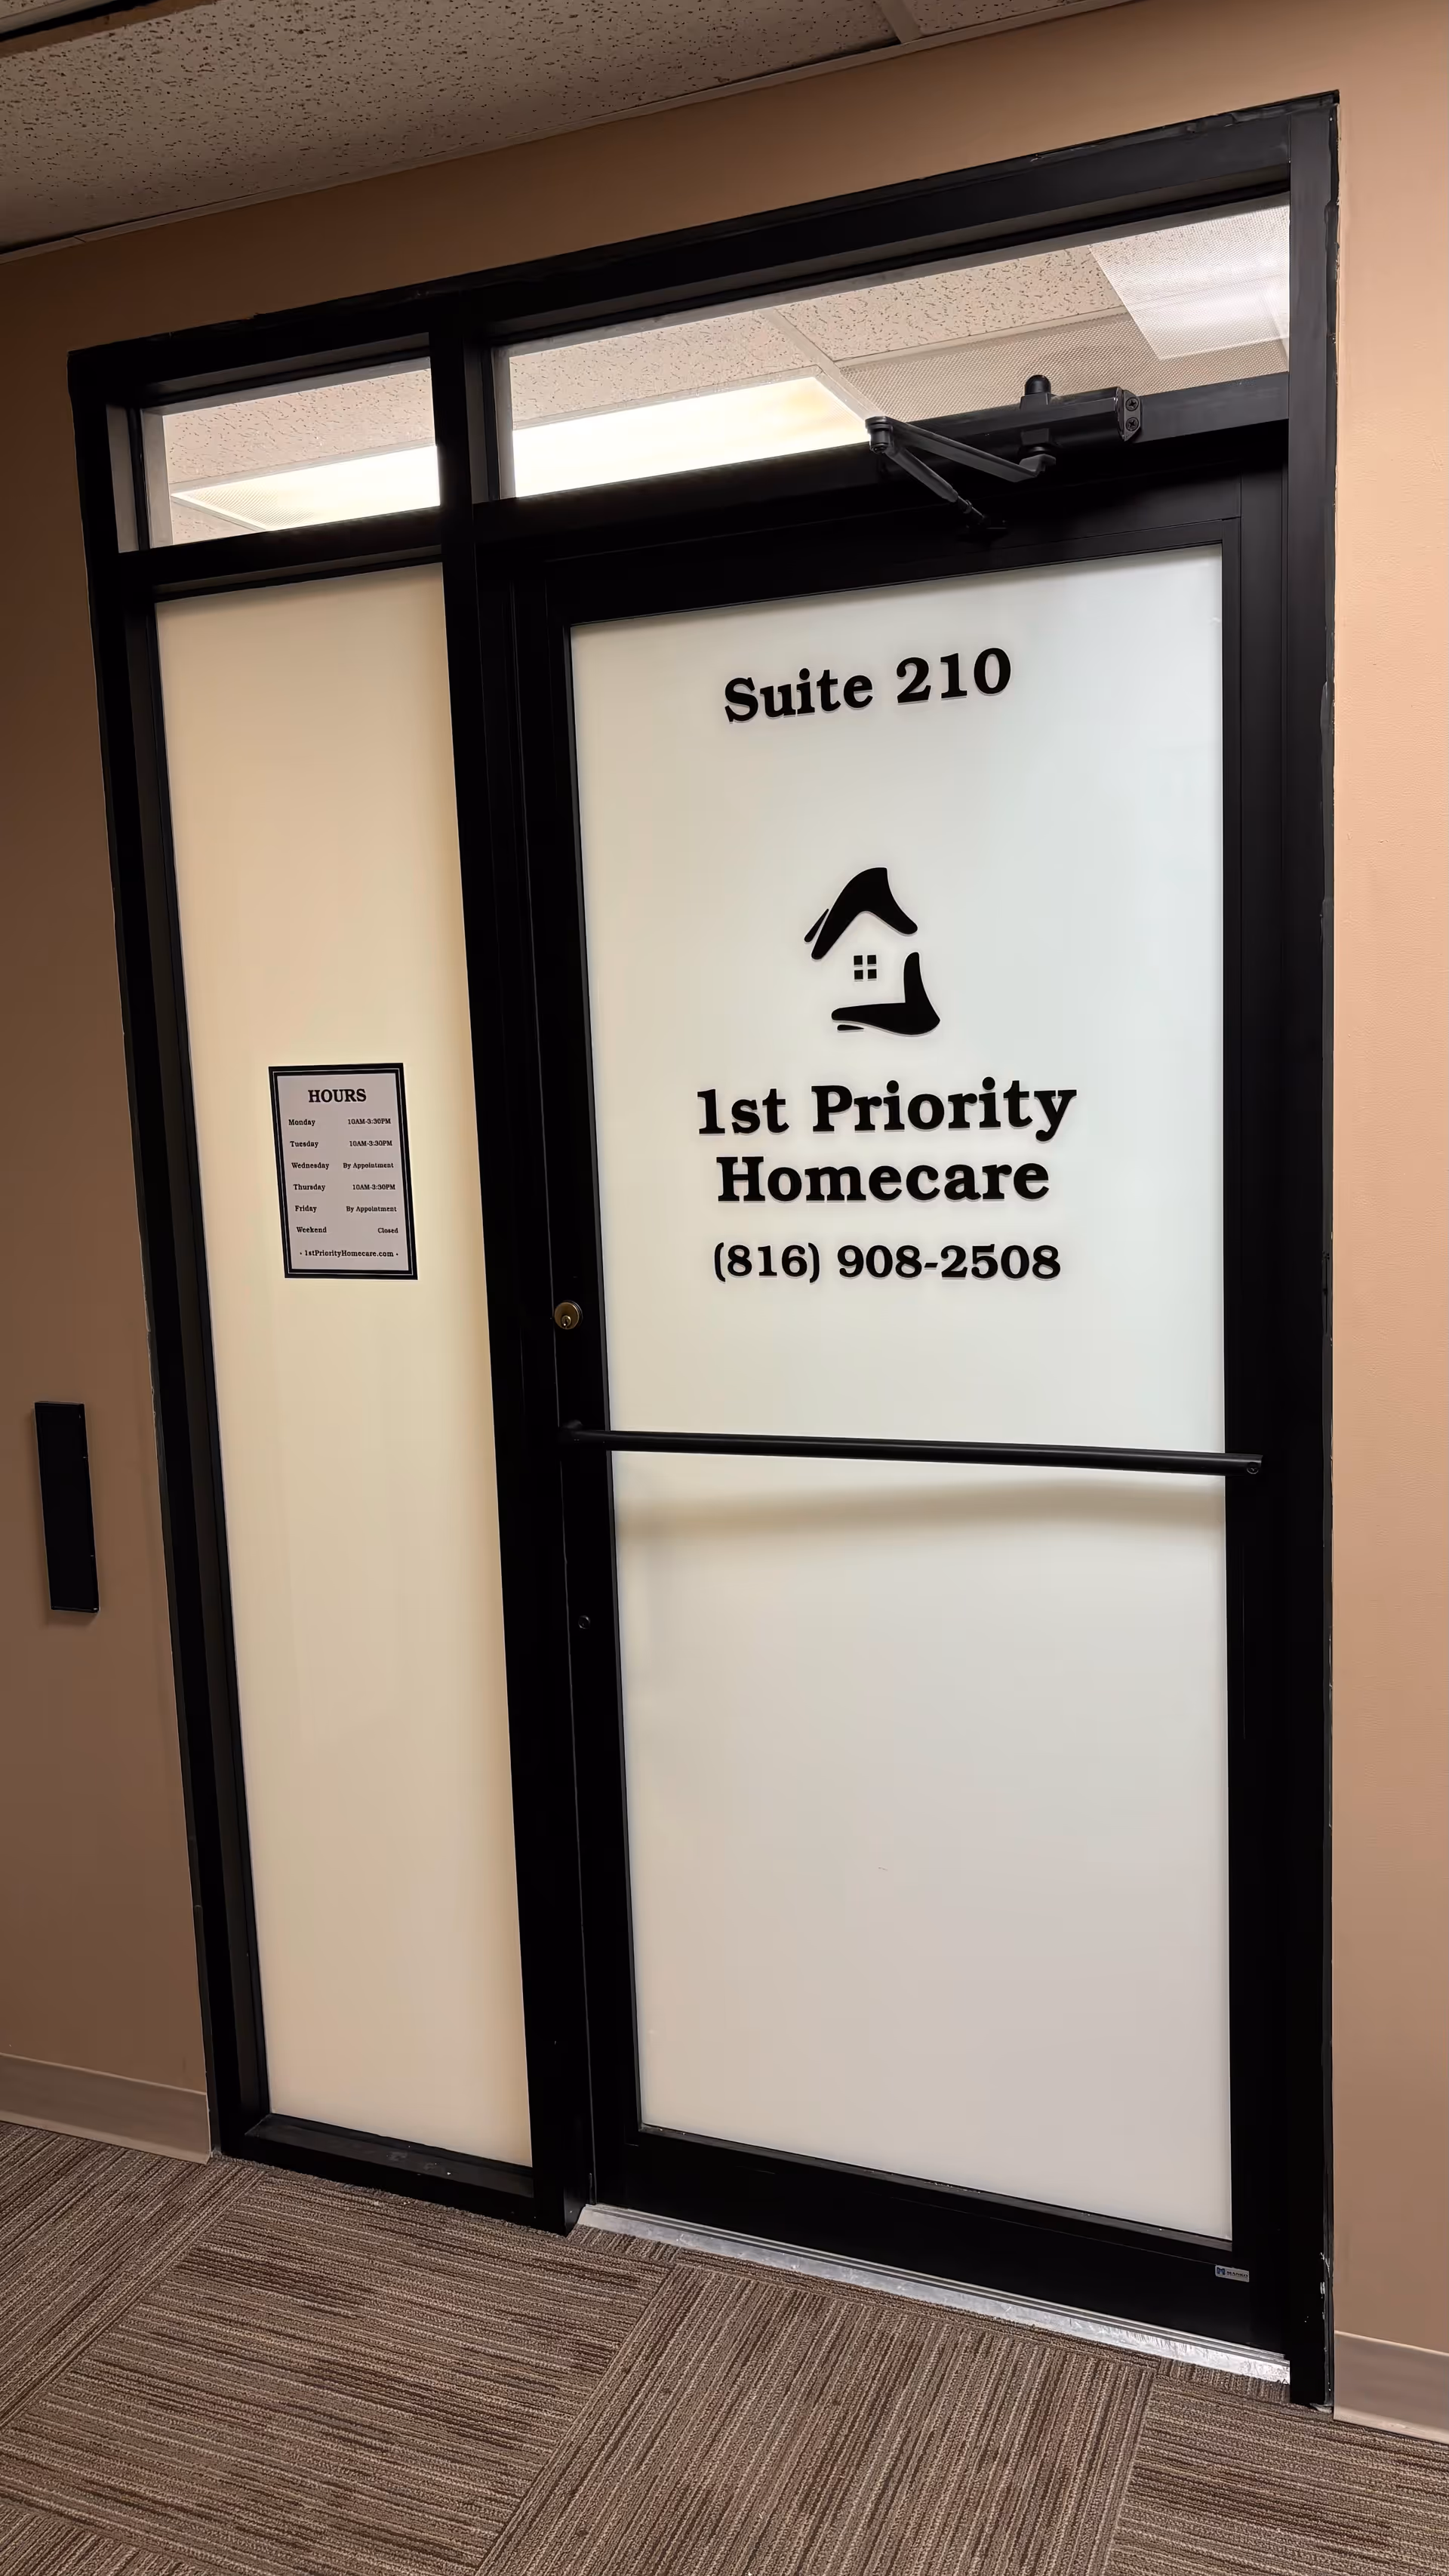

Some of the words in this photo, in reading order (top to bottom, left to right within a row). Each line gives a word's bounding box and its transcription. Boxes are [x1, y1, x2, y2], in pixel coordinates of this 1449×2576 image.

[724, 667, 873, 724] Suite
[896, 647, 1012, 705] 210
[307, 1088, 367, 1103] HOURS
[697, 1088, 790, 1135] 1st
[811, 1076, 1077, 1143] Priority
[288, 1118, 316, 1127] Monday
[289, 1140, 319, 1149] Tuesday
[291, 1162, 330, 1171] Wednesday
[343, 1162, 352, 1170] By
[352, 1162, 394, 1171] Appointment
[715, 1156, 1050, 1202] Homecare
[292, 1183, 326, 1192] Thursday
[294, 1205, 318, 1214] Friday
[346, 1205, 355, 1214] By
[355, 1205, 397, 1214] Appointment
[296, 1226, 328, 1234] Weekend
[377, 1226, 398, 1235] Closed
[304, 1249, 394, 1259] 1stPriorityHomecare.com
[714, 1242, 820, 1284] (816)
[837, 1243, 1061, 1280] 908-2508
